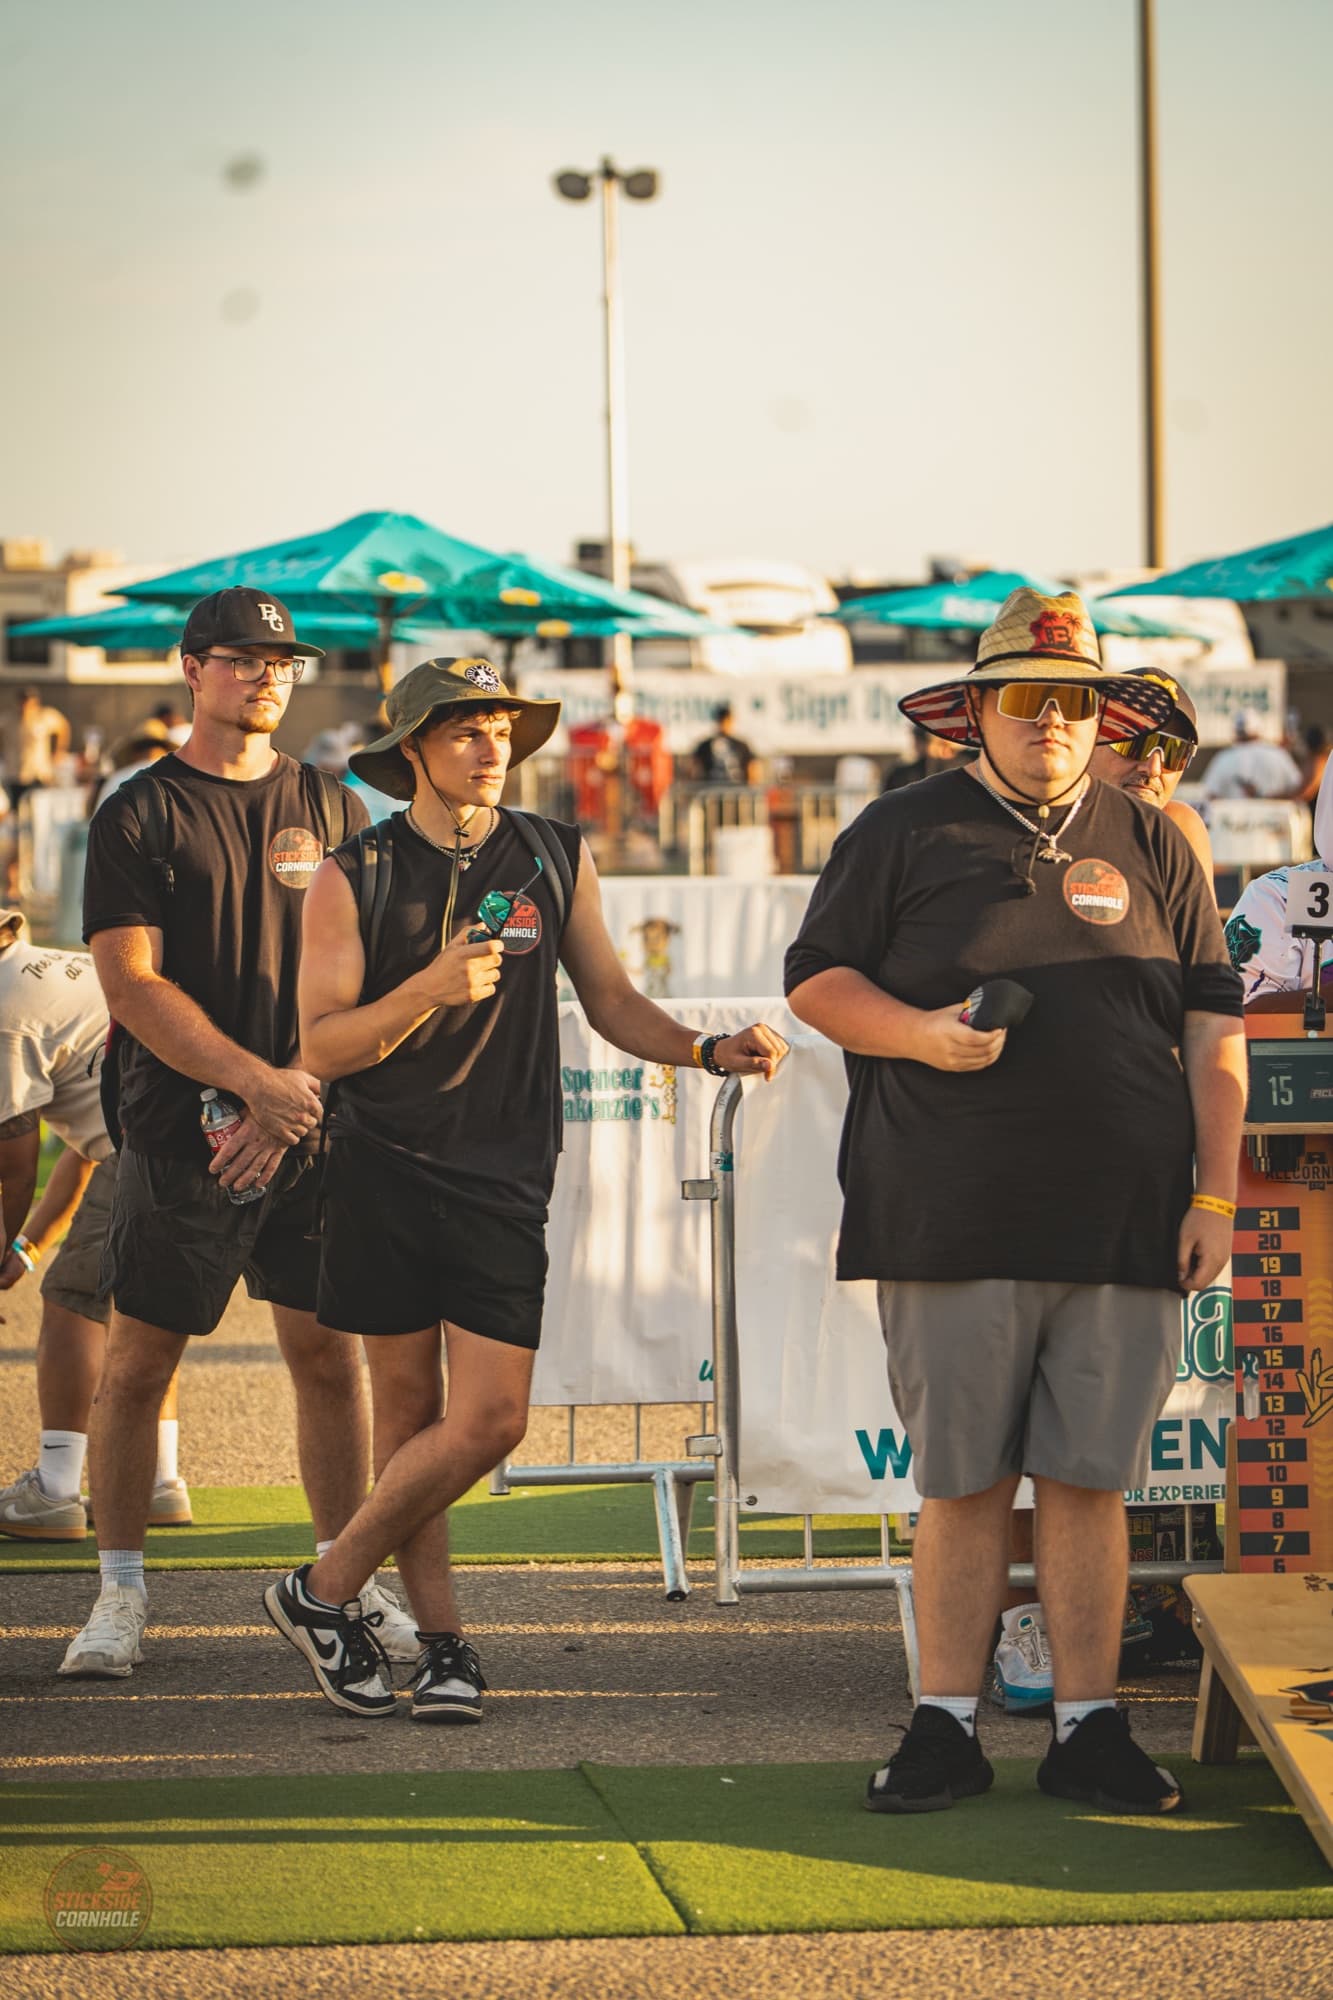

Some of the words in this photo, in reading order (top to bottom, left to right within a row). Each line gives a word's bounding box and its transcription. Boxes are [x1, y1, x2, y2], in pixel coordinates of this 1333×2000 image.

[257, 603, 284, 632] BG
[1071, 894, 1124, 910] CORNHOLE
[1306, 882, 1330, 918] 3
[501, 927, 537, 938] RNHOLE
[562, 1066, 644, 1096] Spencer
[1268, 1075, 1294, 1106] 15
[1258, 1210, 1280, 1228] 21
[1258, 1233, 1281, 1250] 20
[1260, 1256, 1281, 1274] 19
[1261, 1279, 1281, 1297] 18
[1262, 1302, 1281, 1320] 17
[1262, 1326, 1283, 1343] 16
[1263, 1349, 1284, 1366] 15
[1263, 1372, 1285, 1390] 14
[1265, 1395, 1285, 1413] 13
[1265, 1418, 1286, 1436] 12
[1267, 1442, 1285, 1459] 11
[1266, 1465, 1287, 1483] 10
[1271, 1488, 1284, 1506] 9
[1272, 1512, 1284, 1529] 8
[1273, 1535, 1285, 1553] 7
[1273, 1558, 1286, 1574] 6
